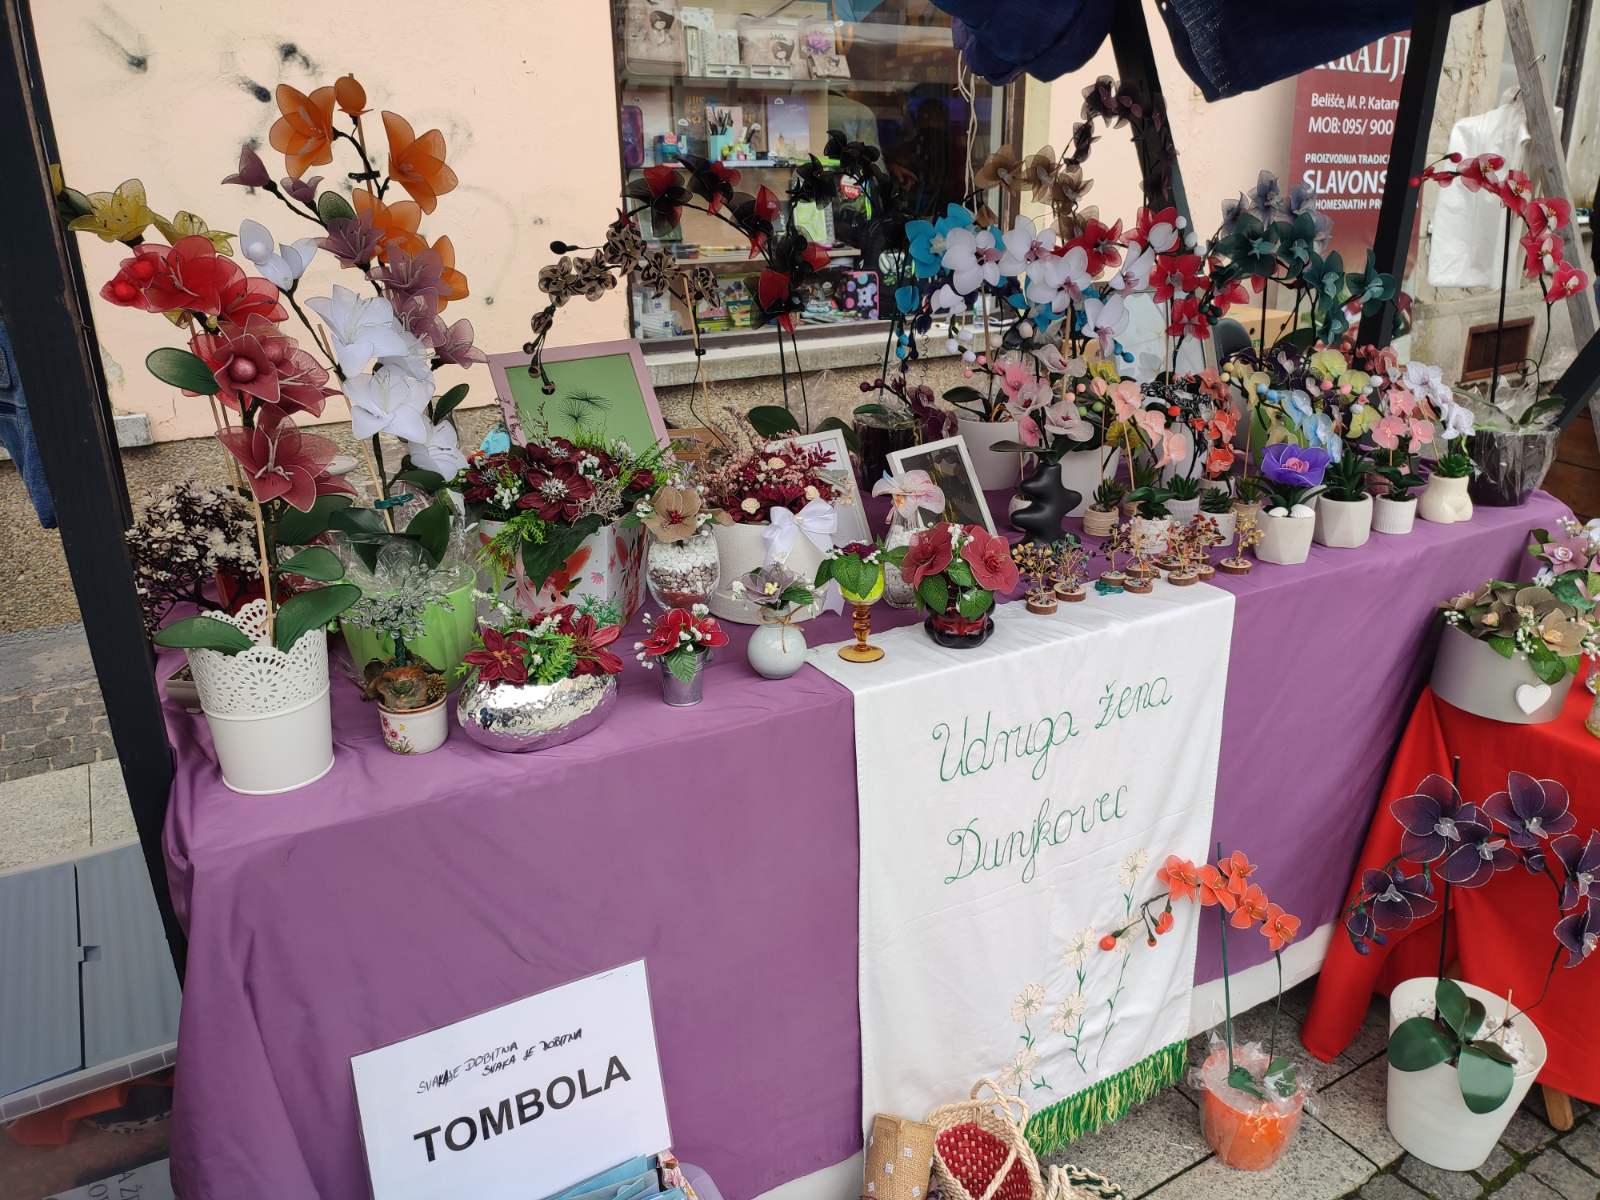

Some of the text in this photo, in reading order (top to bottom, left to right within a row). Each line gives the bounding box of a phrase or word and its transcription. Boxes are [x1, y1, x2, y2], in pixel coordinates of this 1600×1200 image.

[1311, 92, 1345, 109] Belišće,
[1347, 95, 1357, 108] M.
[1359, 96, 1366, 109] P.
[1308, 116, 1394, 135] MOB: 095/ 900
[1305, 153, 1357, 163] PROIZVODNJA
[932, 711, 1079, 782] Udruga
[464, 1041, 518, 1071] DOBITNA
[413, 1055, 631, 1162] TOMBOLA
